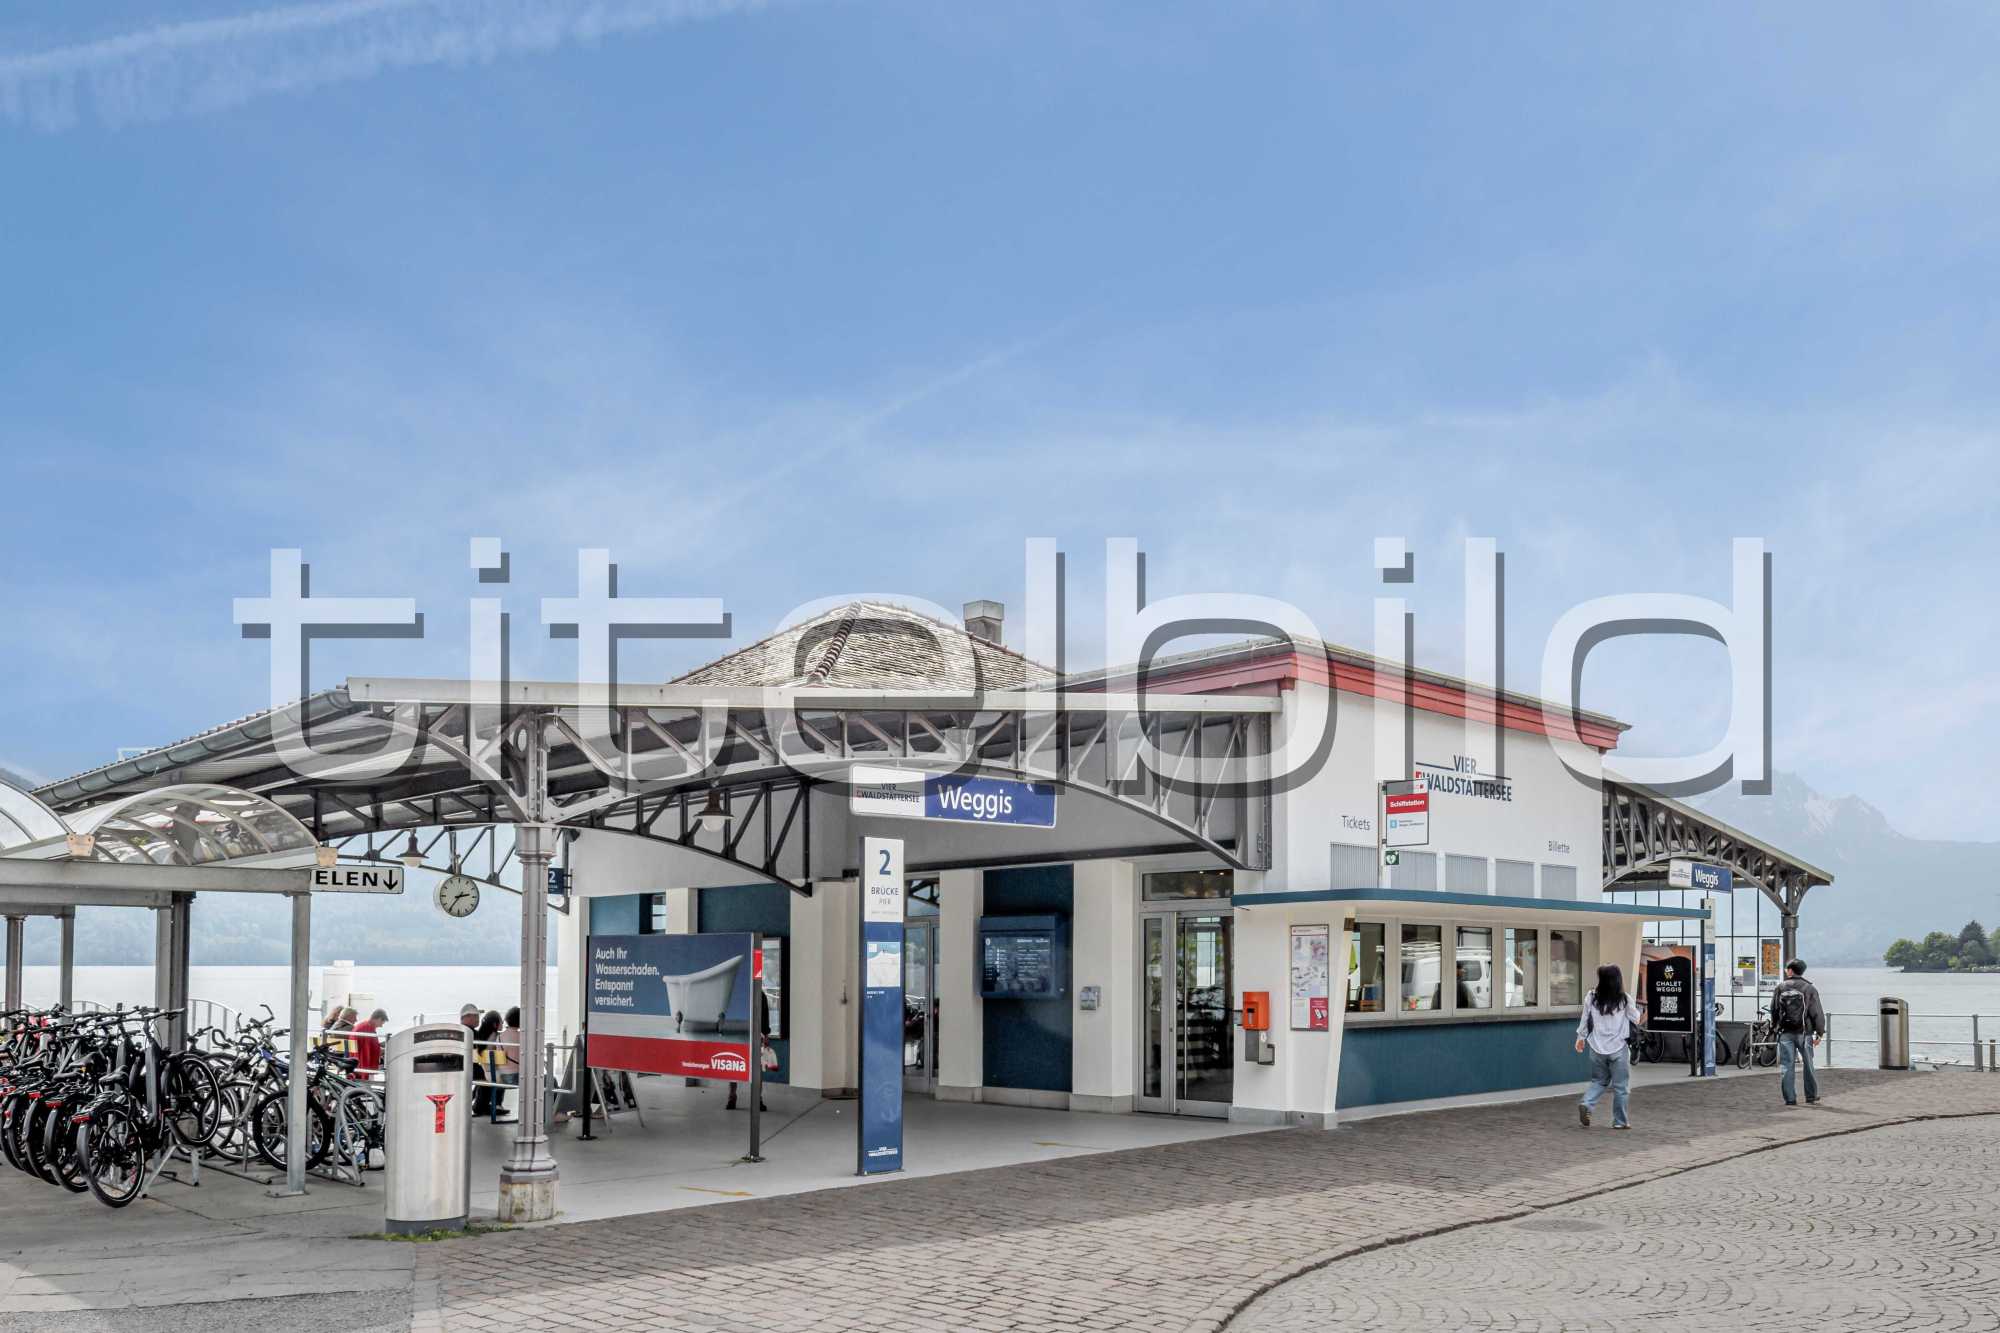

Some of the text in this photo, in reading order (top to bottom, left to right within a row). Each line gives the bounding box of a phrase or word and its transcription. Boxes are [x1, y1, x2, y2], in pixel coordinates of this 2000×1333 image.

[1453, 754, 1477, 775] VIER
[881, 783, 897, 791] VIER
[1422, 772, 1512, 802] WALDSTÄTTERSEE
[937, 783, 1013, 819] Weggis
[1390, 799, 1425, 808] Schiffstation
[1341, 815, 1371, 831] Tickets
[879, 849, 892, 876] 2
[310, 871, 378, 887] ELEN
[1695, 868, 1719, 888] Weggis
[595, 946, 628, 960] Auch Ihr
[595, 963, 660, 976] Wasserschaden.
[595, 978, 634, 994] Entspannt
[594, 994, 635, 1007] versichert.
